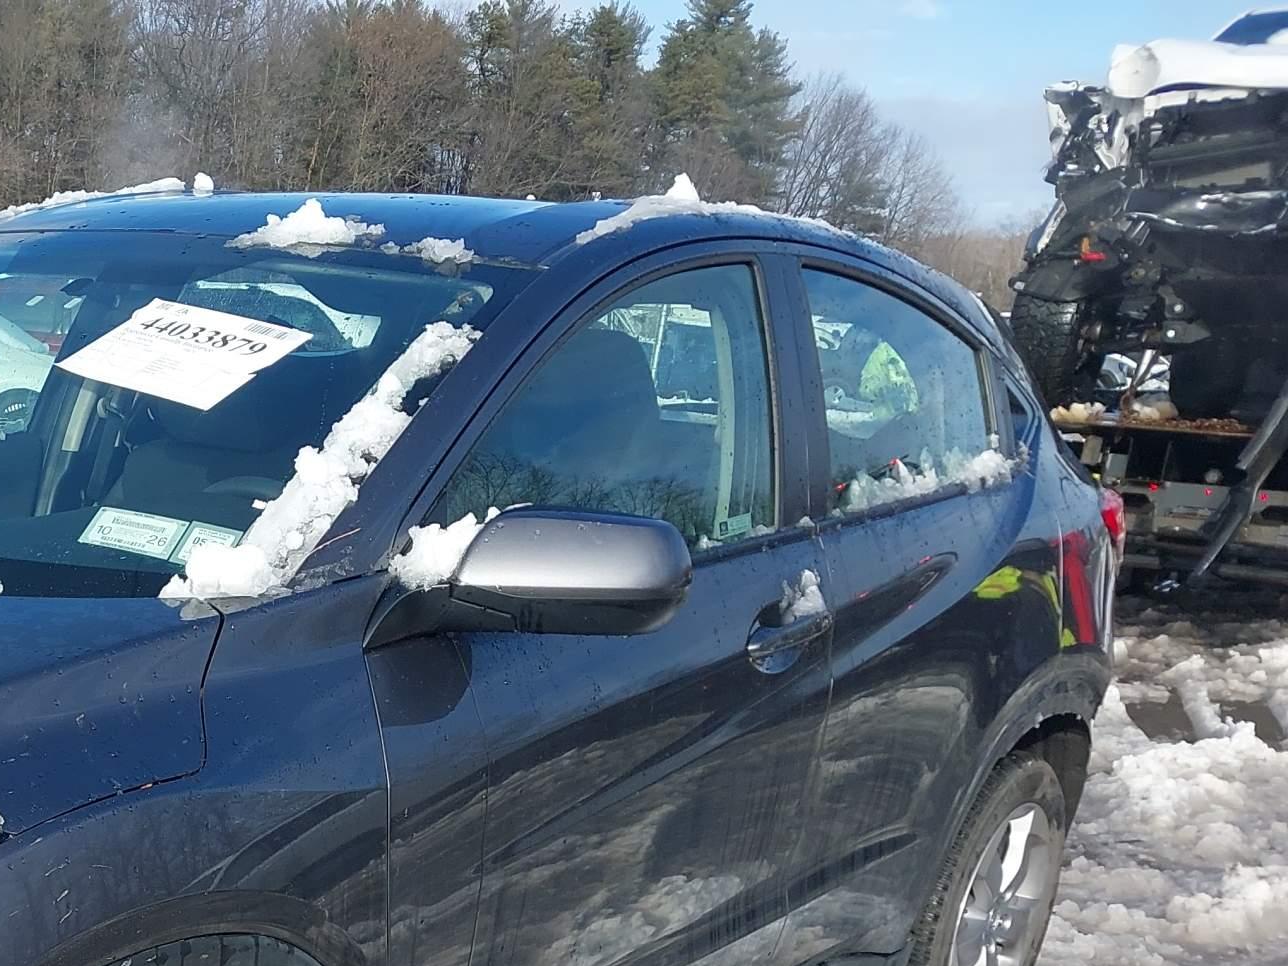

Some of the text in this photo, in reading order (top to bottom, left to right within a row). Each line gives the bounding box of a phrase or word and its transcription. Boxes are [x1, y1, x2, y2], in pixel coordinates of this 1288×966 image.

[140, 317, 267, 355] 44033879
[96, 525, 113, 536] 10
[146, 534, 168, 547] 26
